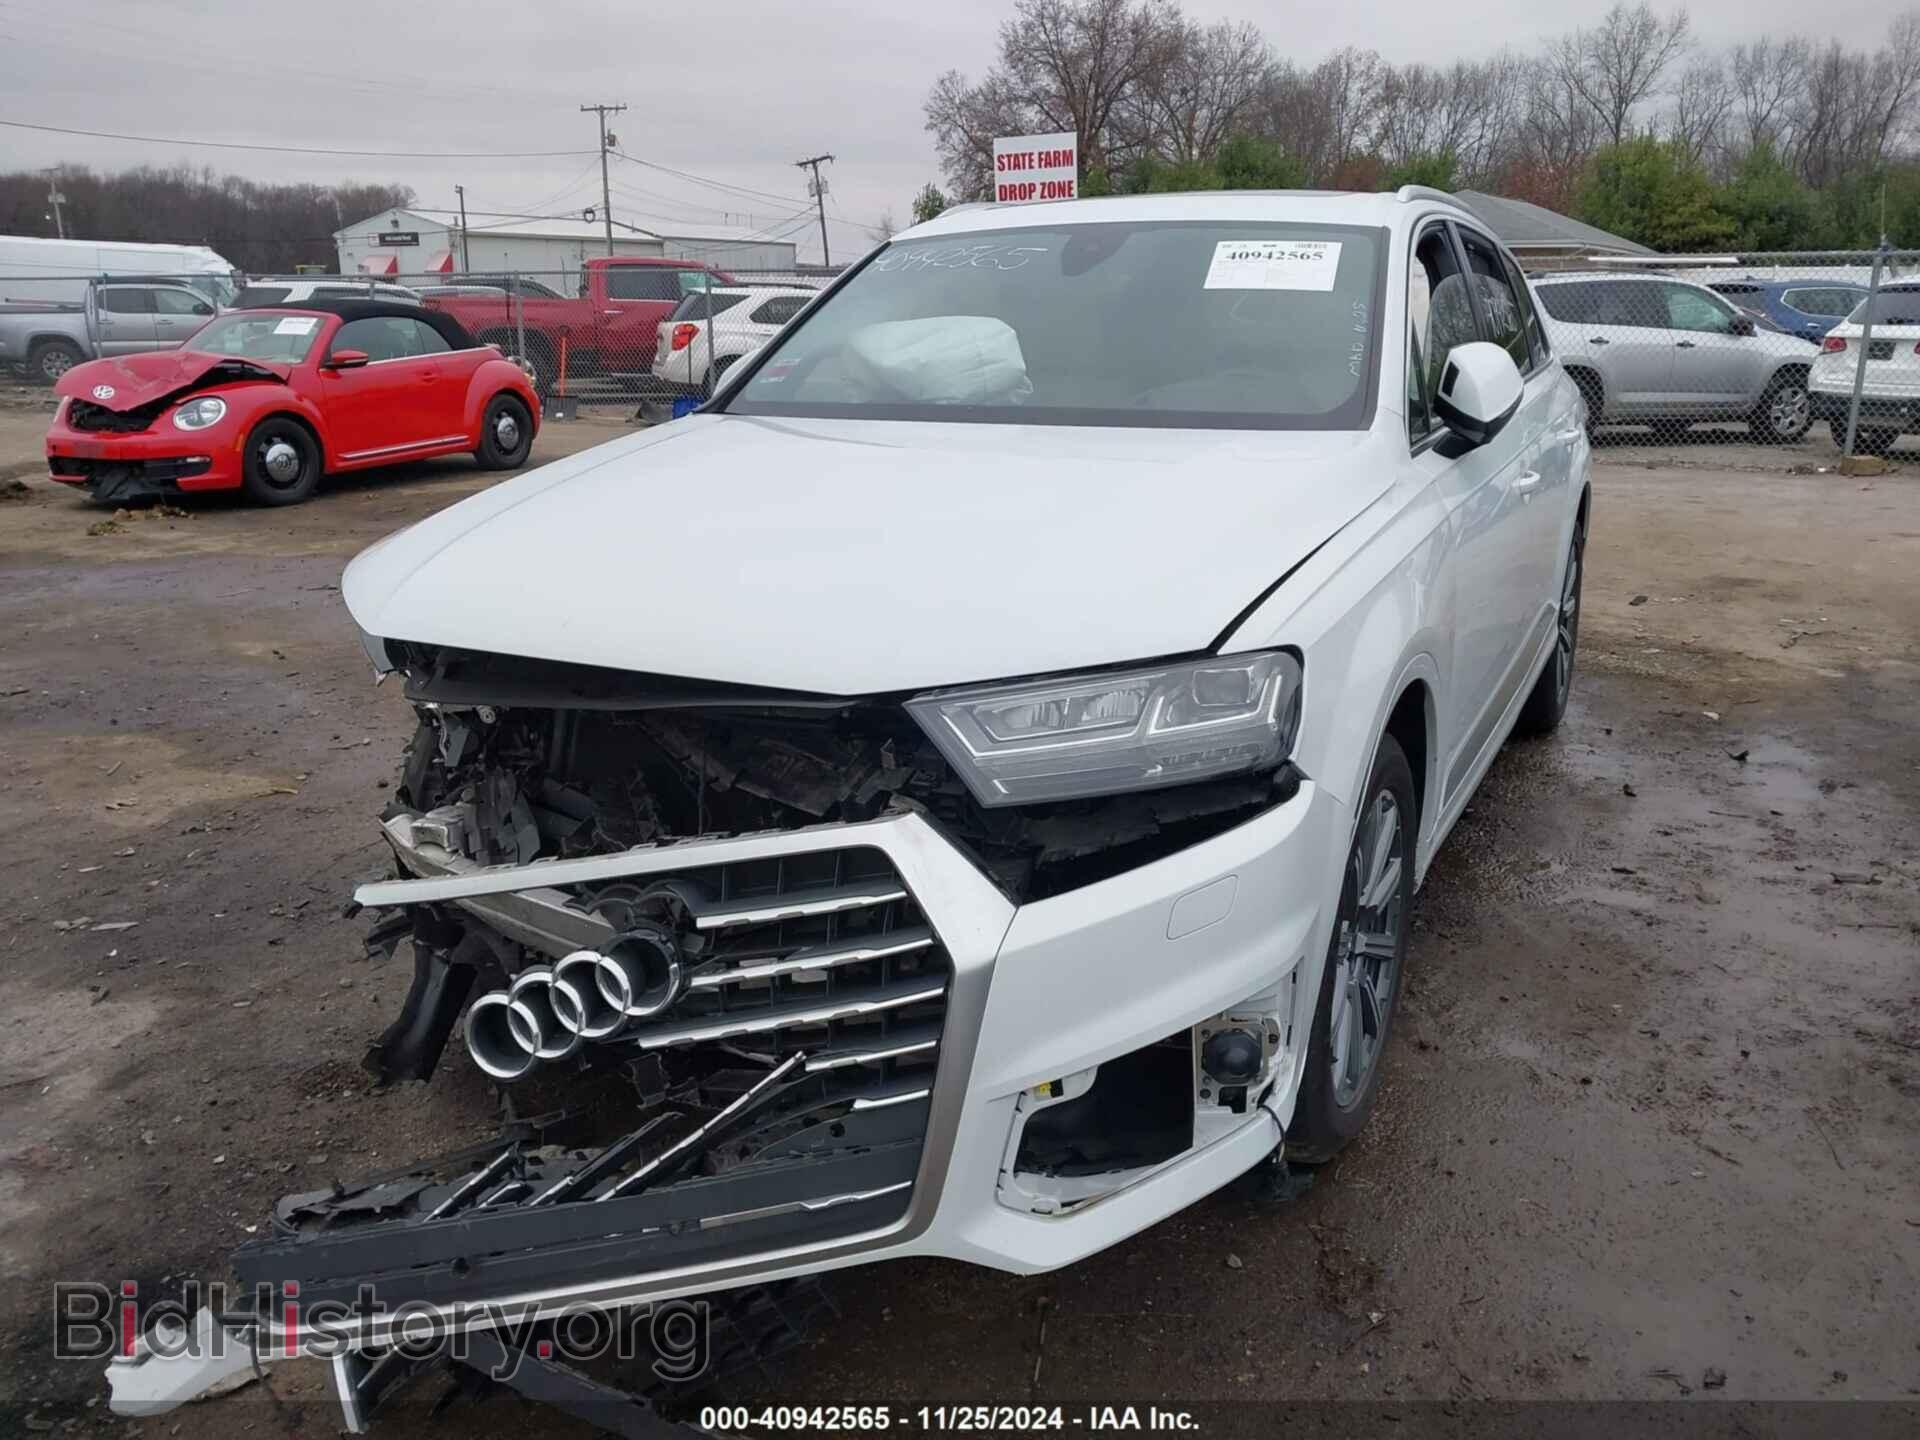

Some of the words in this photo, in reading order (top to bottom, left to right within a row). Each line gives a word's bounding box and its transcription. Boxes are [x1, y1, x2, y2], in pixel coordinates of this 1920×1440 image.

[997, 152, 1035, 171] STATE
[1038, 149, 1074, 169] FARM
[998, 182, 1036, 201] DROP
[1040, 180, 1075, 199] ZONE
[1225, 250, 1325, 261] 40942565
